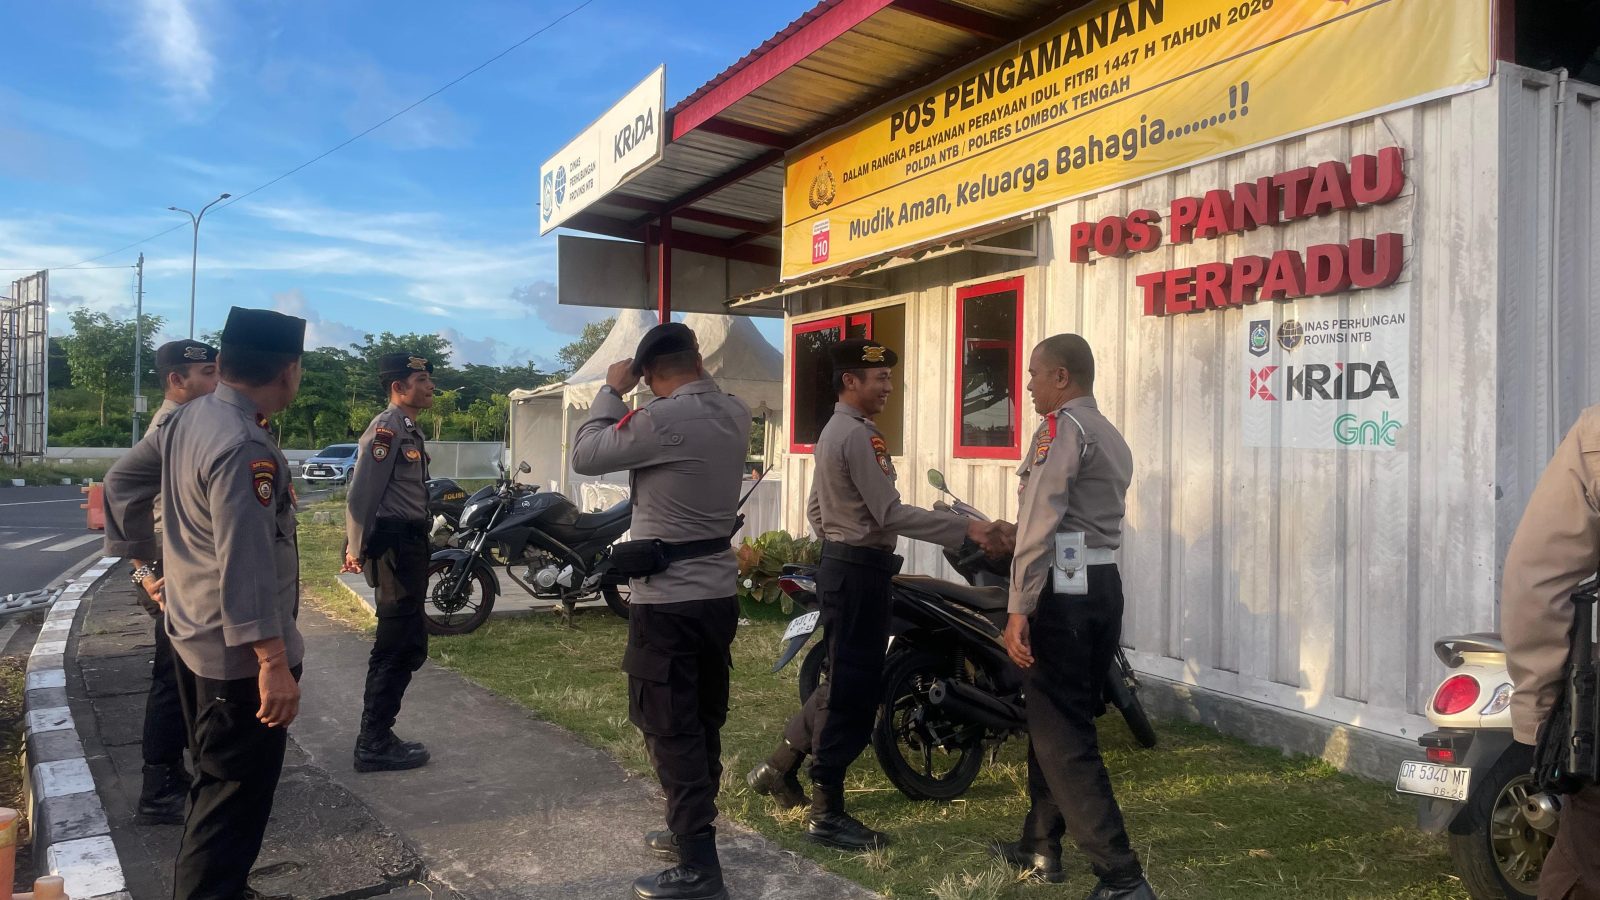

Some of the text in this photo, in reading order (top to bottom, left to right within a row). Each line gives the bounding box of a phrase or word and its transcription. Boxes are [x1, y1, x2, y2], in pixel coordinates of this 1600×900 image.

[843, 162, 869, 183] DALAM
[871, 147, 906, 172] RANGKA
[909, 123, 965, 156] PELAYANAN
[968, 96, 1027, 132] PERAYAAN
[1031, 83, 1060, 106] IDUL
[1064, 64, 1099, 92] FITRI
[1104, 48, 1139, 75] 1447
[1144, 41, 1156, 59] H
[1161, 13, 1221, 52] TAHUN
[890, 0, 1164, 141] POS PENGAMANAN
[906, 156, 936, 176] POLDA
[939, 144, 959, 163] NTB
[968, 124, 1011, 152] POLRES
[1015, 100, 1069, 134] LOMBOK
[1072, 75, 1130, 110] TENGAH
[849, 206, 895, 241] Mudik
[898, 193, 951, 226] Aman,
[957, 158, 1049, 207] Keluarga
[1070, 147, 1405, 263] POS PANTAU
[814, 239, 828, 258] 110
[1136, 232, 1404, 316] TERPADU
[1350, 332, 1372, 343] NTB
[1402, 763, 1468, 785] DR 5340 MT
